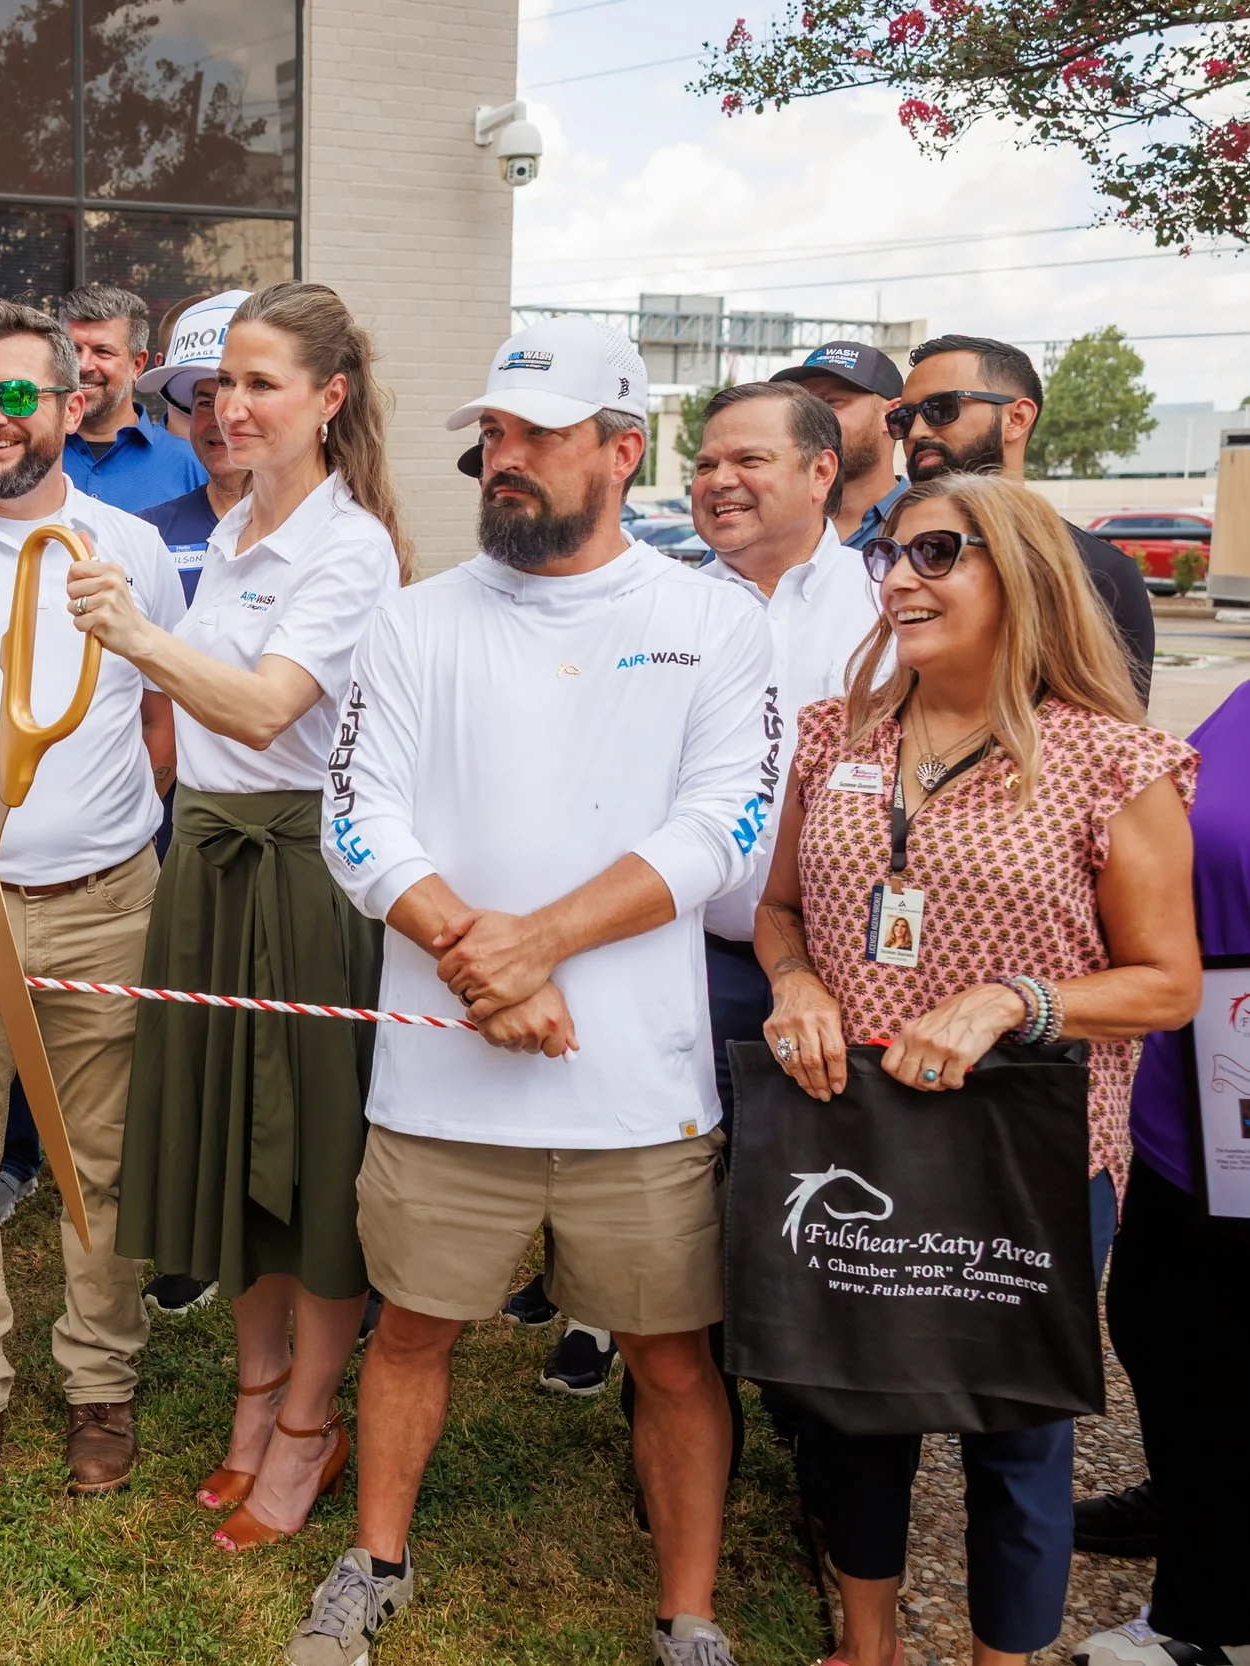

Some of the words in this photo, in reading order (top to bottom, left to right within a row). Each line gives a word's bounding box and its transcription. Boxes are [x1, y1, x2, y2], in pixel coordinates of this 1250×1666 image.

[825, 349, 859, 359] WASH
[174, 554, 204, 565] ILSON
[616, 653, 645, 669] AIR
[650, 652, 700, 667] WASH
[804, 1222, 984, 1267] Fulshear-Katy
[991, 1238, 1053, 1269] Area
[808, 1255, 821, 1269] A
[827, 1257, 897, 1279] Chamber
[961, 1267, 1049, 1294] Commerce
[828, 1279, 1022, 1306] www.FulshearKaty.com
